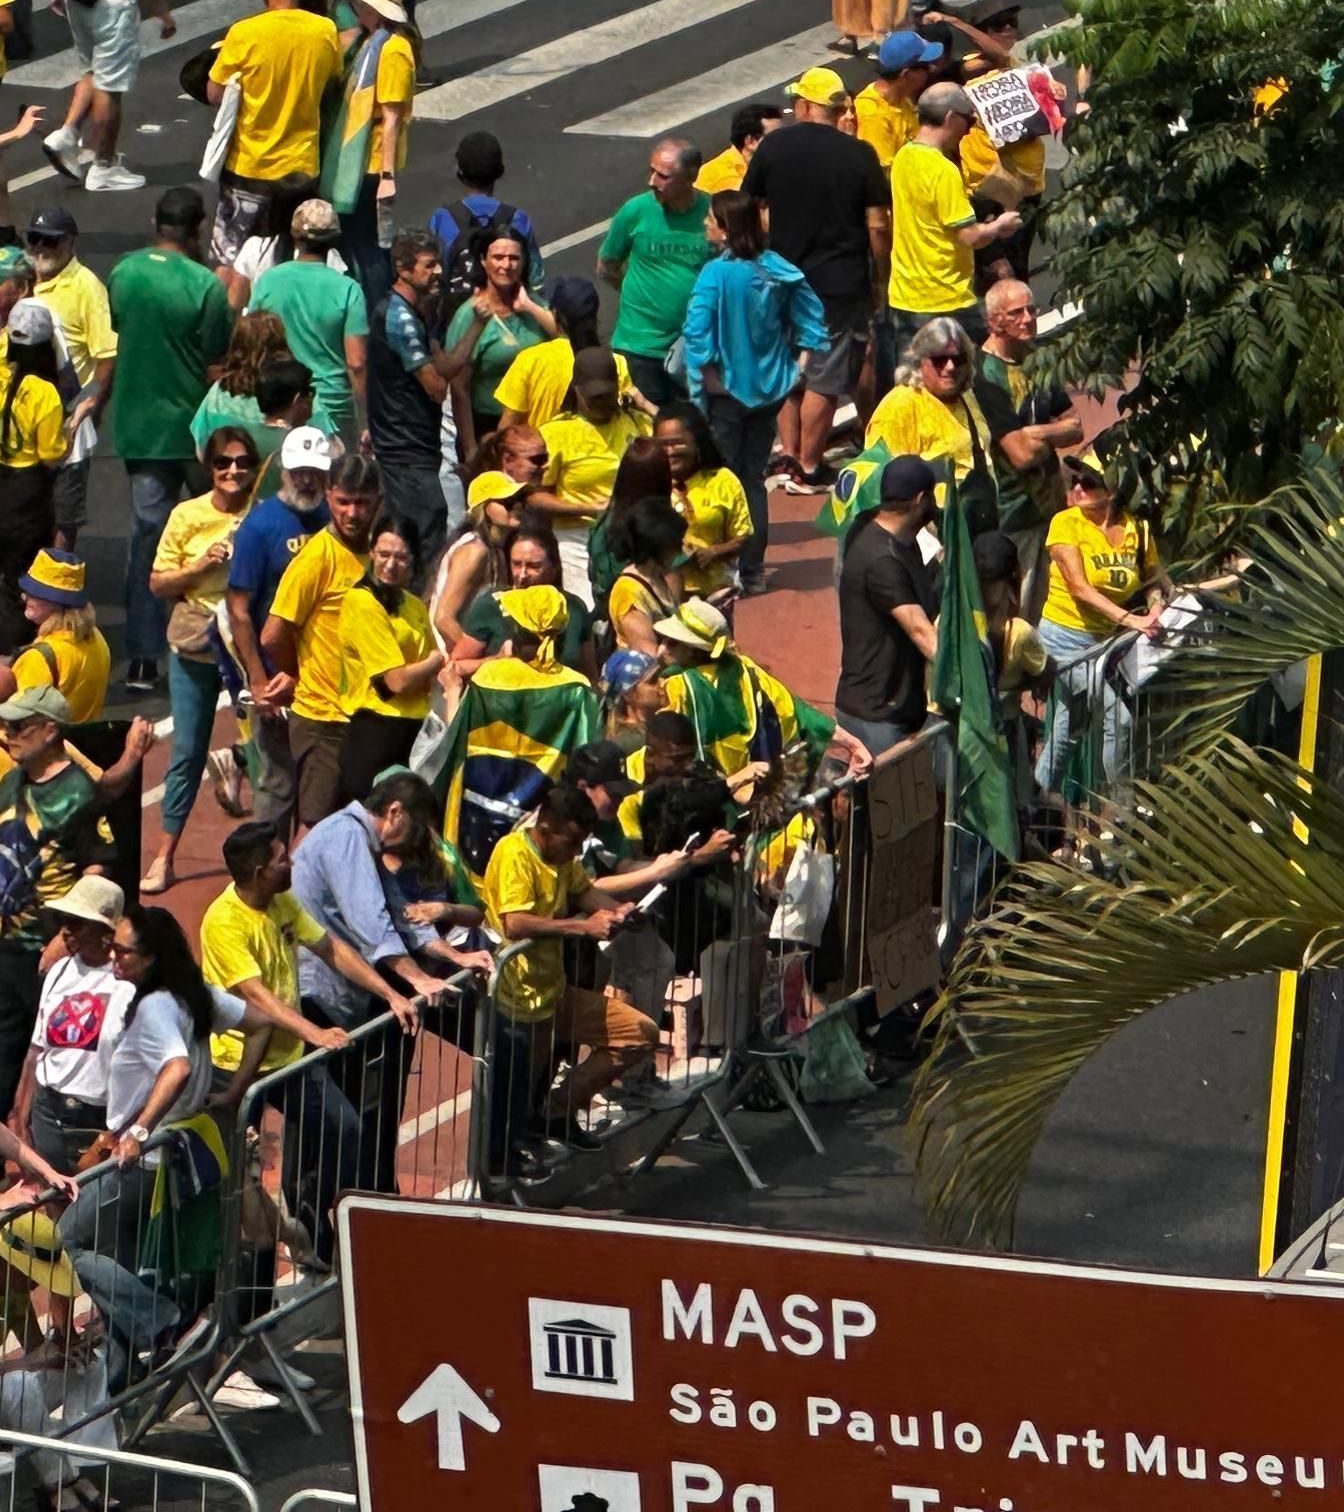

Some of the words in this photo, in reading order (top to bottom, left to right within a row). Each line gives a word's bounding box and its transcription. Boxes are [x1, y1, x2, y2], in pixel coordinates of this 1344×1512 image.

[661, 1278, 877, 1360] MASP
[669, 1383, 777, 1432] São
[807, 1396, 983, 1454] Paulo
[1008, 1420, 1106, 1470] Art
[1125, 1432, 1344, 1489] Museu
